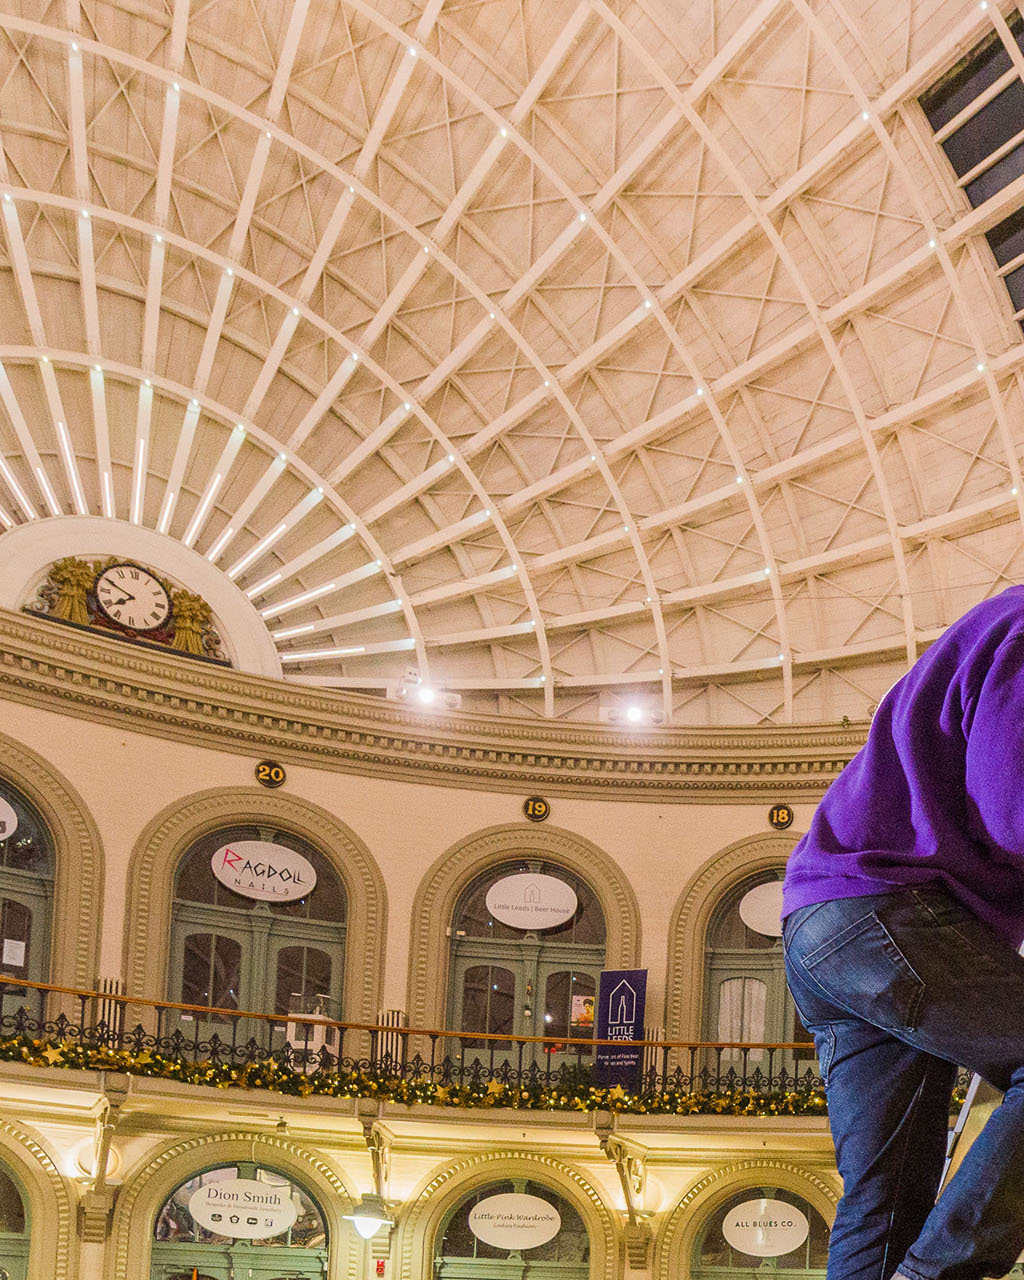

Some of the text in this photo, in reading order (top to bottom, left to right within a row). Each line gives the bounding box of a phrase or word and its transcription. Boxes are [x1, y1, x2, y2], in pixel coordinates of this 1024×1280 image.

[258, 765, 284, 782] 20
[528, 800, 546, 815] 19
[772, 809, 789, 823] 18
[234, 878, 289, 895] NAILS
[511, 904, 530, 912] Leeds
[607, 1025, 635, 1036] LITTLE
[207, 1187, 281, 1205] Dion Smith
[752, 1220, 778, 1228] BLUES
